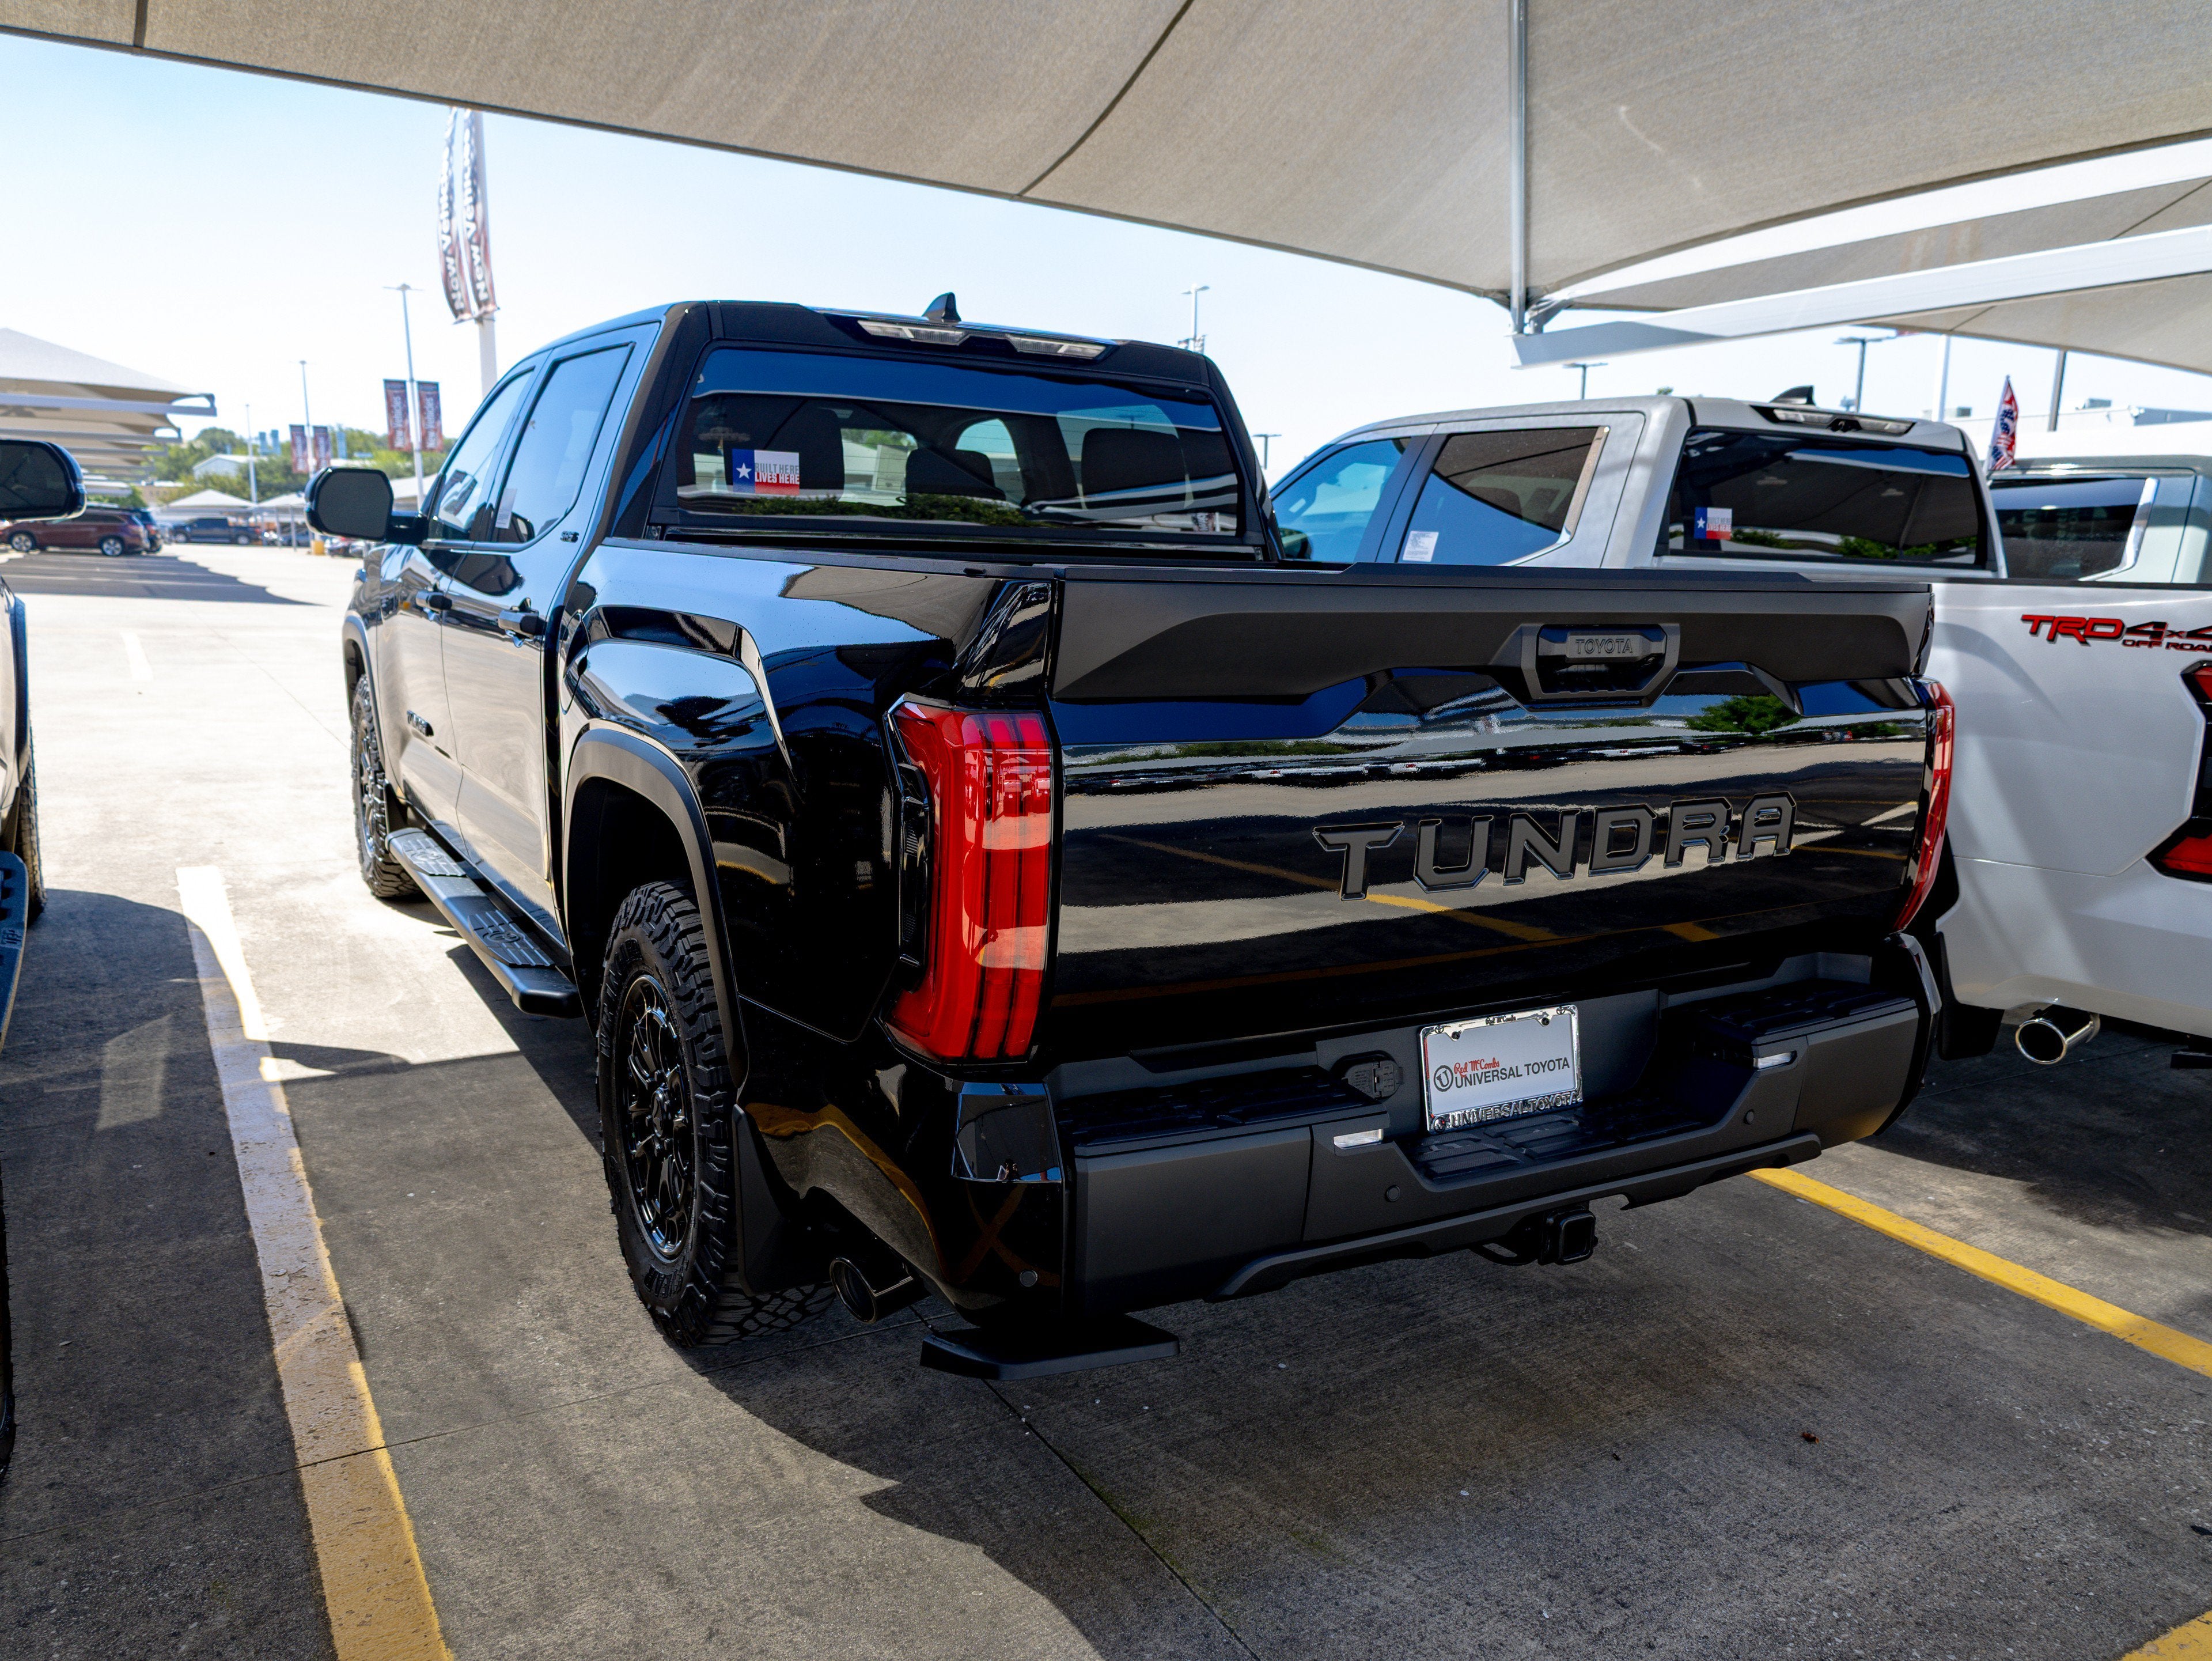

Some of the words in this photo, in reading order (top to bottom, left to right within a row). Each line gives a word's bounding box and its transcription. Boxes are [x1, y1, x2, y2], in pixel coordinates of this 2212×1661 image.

[471, 244, 488, 301] New
[755, 463, 777, 474] BUILT
[779, 464, 800, 475] HERE
[755, 472, 777, 483] LIVES
[779, 474, 800, 485] HERE
[2021, 614, 2126, 646] TRD
[1575, 638, 1633, 654] TOYOTA
[2122, 639, 2162, 648] OFF
[2165, 642, 2212, 652] ROA
[1312, 790, 1797, 902] TUNDRA
[1454, 1062, 1468, 1077] Red
[1469, 1057, 1500, 1072] McCombs
[1455, 1066, 1523, 1088] UNIVERSAL
[1524, 1057, 1570, 1076] TOYOTA
[1451, 1102, 1528, 1128] UNIVERSAL
[1527, 1091, 1579, 1113] TOYOTA
